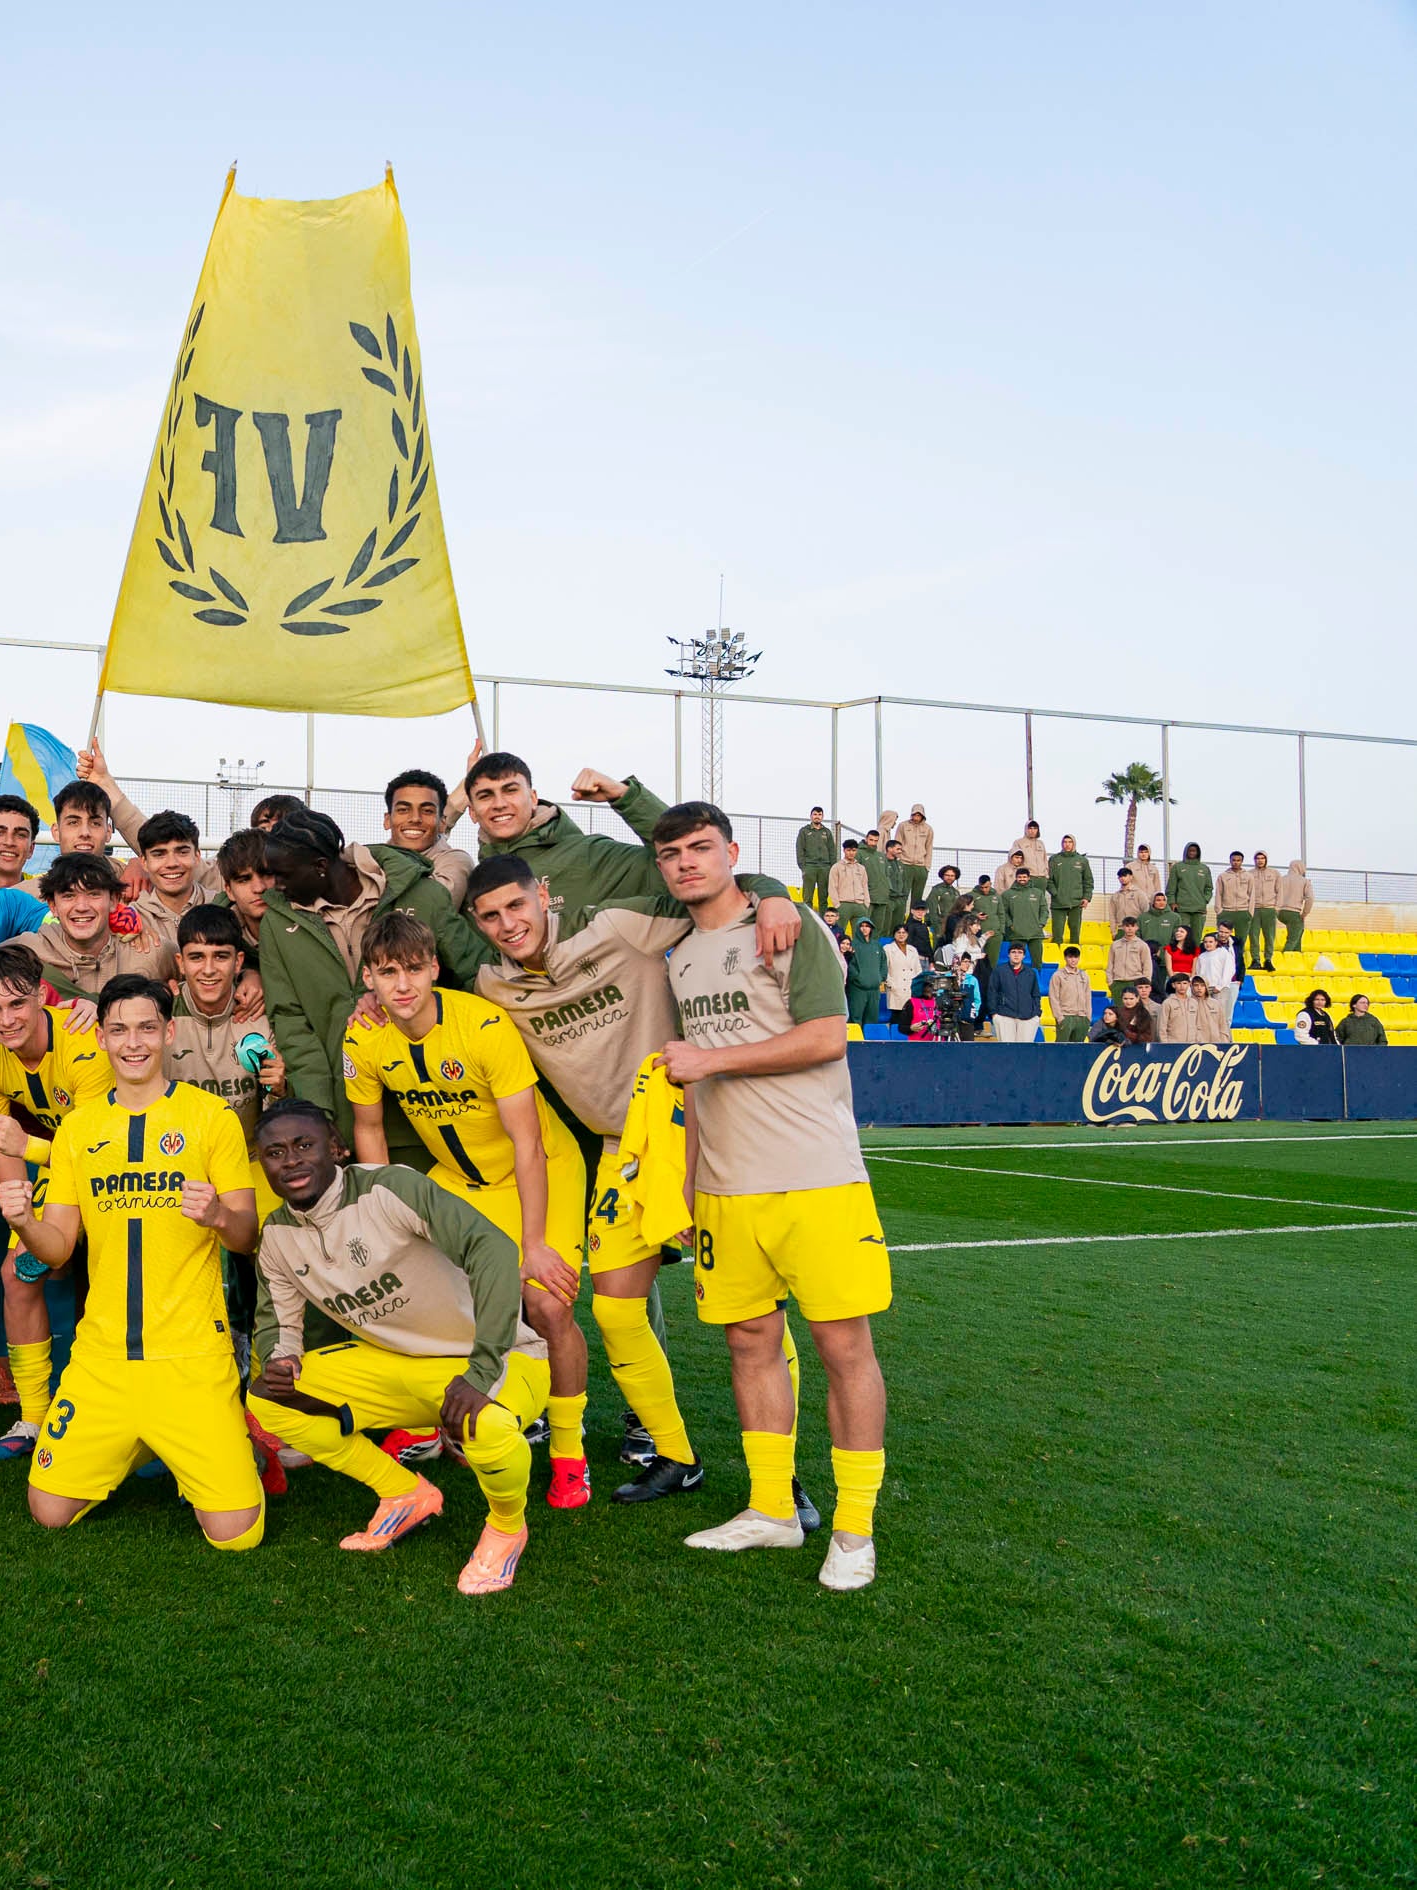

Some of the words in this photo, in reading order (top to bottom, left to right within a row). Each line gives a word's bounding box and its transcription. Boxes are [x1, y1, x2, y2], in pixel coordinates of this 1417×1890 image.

[548, 896, 564, 905] ESA
[529, 984, 625, 1035] PAMESA
[1082, 1044, 1249, 1122] Coca-Cola
[90, 1171, 186, 1197] PAMESA
[97, 1195, 182, 1212] ceámica
[323, 1272, 403, 1315] AMESA
[47, 1399, 76, 1440] 3
